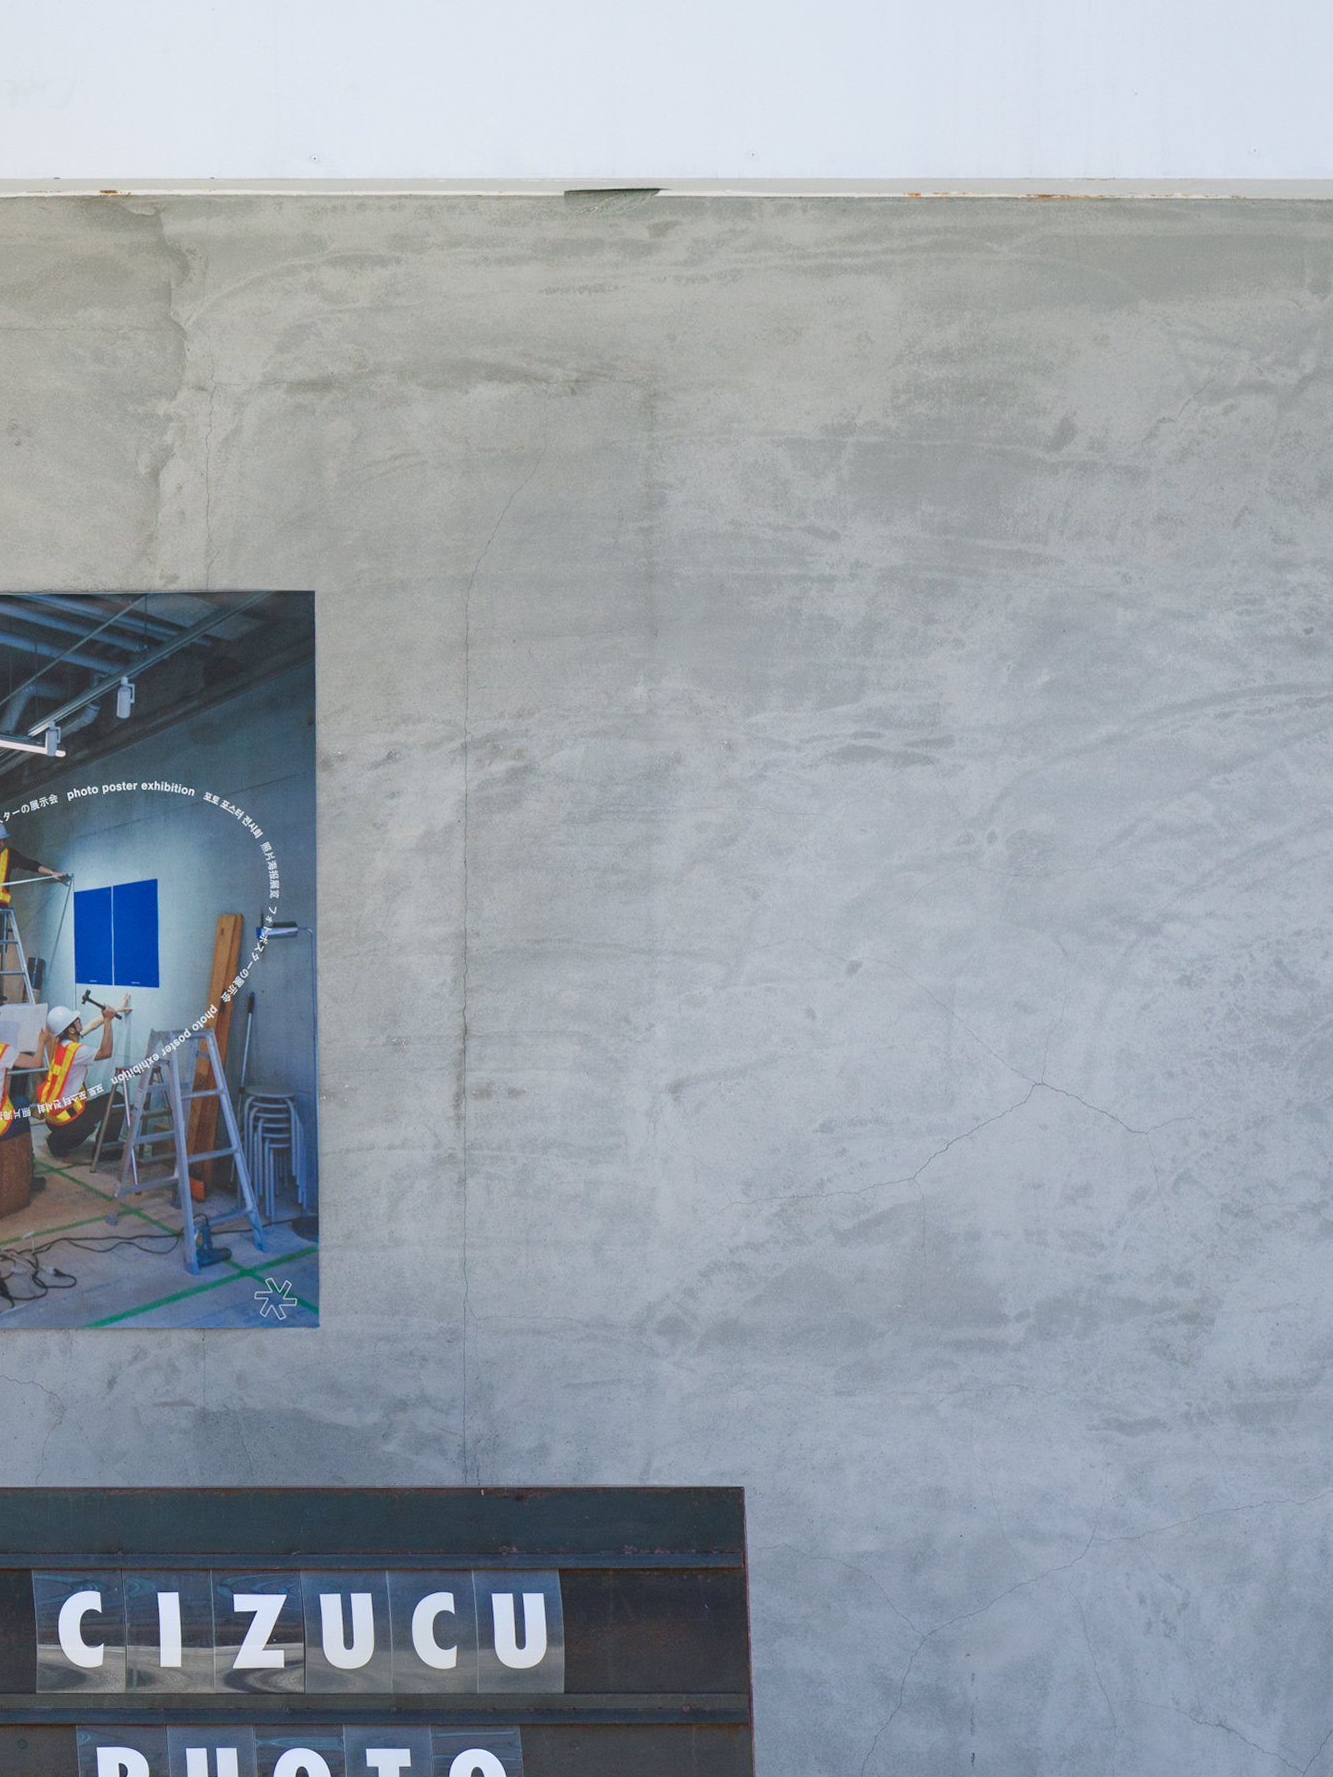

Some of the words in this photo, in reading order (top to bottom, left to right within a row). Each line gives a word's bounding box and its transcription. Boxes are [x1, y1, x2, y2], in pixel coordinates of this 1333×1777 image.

[66, 784, 99, 801] photo
[102, 781, 138, 794] poster
[140, 780, 196, 797] exhibition
[203, 791, 221, 806] 포토
[219, 799, 245, 820] 포스터
[241, 815, 264, 839] 전시회
[221, 906, 278, 1003] フォトポスターの展示会
[191, 1004, 218, 1031] photo
[161, 1029, 192, 1056] poster
[110, 1053, 161, 1085] exhibition
[62, 1090, 88, 1107] 포스터
[87, 1083, 105, 1097] 포토
[36, 1098, 62, 1114] 전시회
[57, 1590, 549, 1670] CIZUCU
